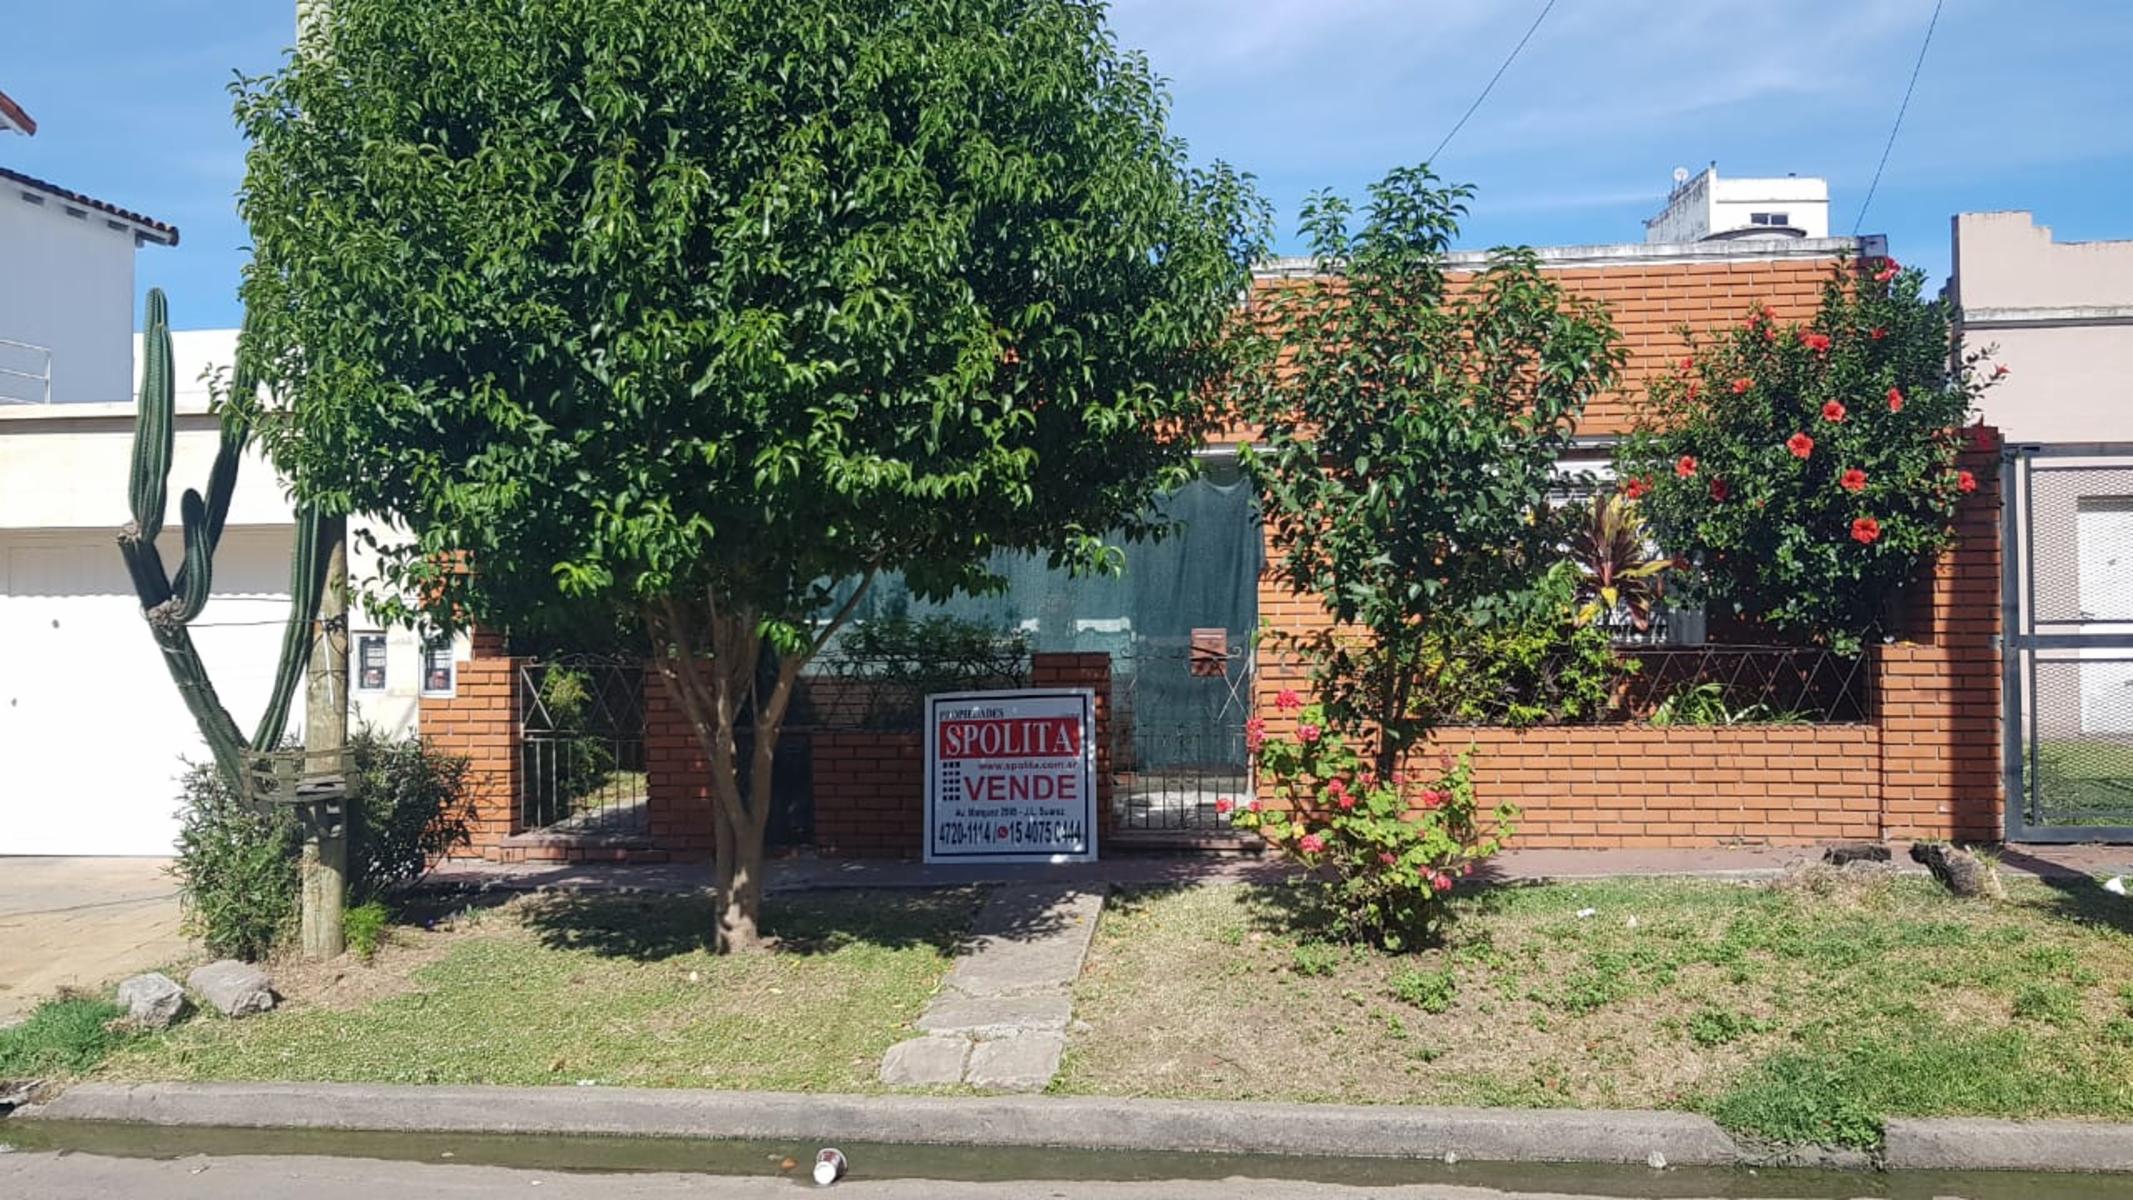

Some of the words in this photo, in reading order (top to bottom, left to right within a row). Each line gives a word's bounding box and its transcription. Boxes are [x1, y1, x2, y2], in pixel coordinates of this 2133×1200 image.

[945, 721, 1073, 756] SPOLITA
[963, 774, 1077, 801] VENDE
[1010, 821, 1022, 843] 15
[1025, 820, 1051, 843] 4075
